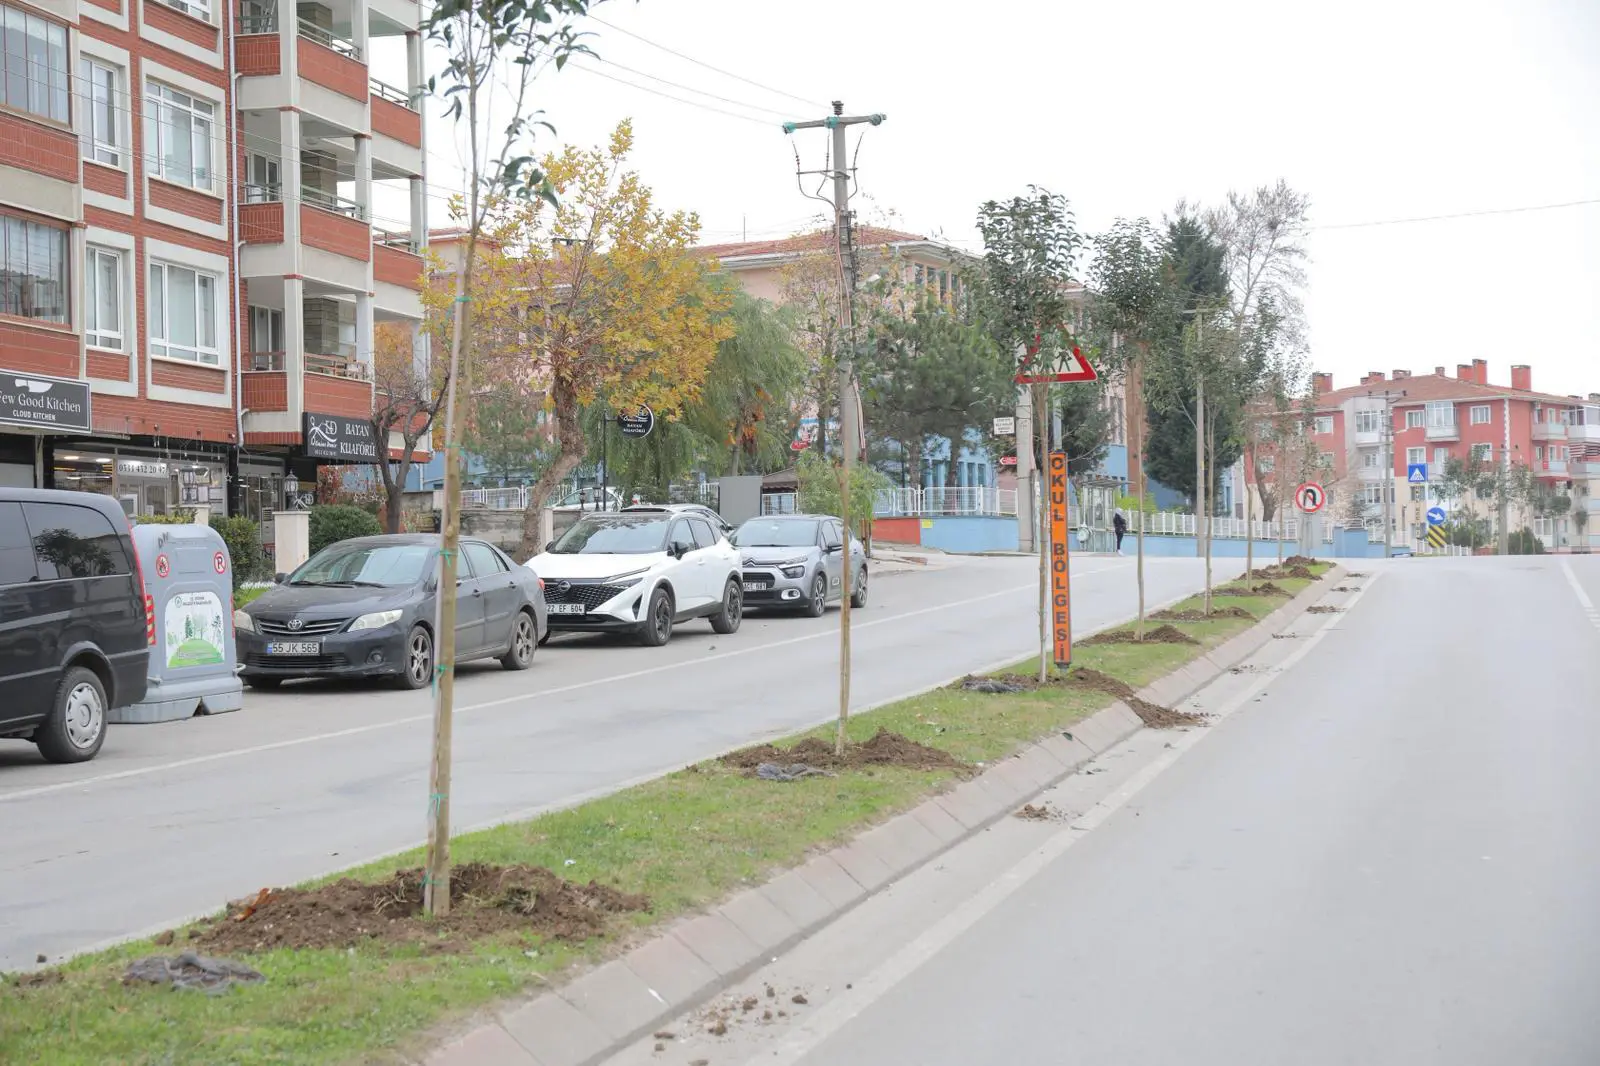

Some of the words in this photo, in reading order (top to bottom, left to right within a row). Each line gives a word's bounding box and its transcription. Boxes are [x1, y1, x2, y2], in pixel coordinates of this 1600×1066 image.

[18, 393, 44, 408] Good
[46, 396, 80, 412] Kitchen
[13, 410, 32, 418] CLOUD
[33, 412, 56, 420] KITCHEN
[346, 424, 370, 436] BAYAN
[1054, 543, 1066, 661] BÖLGESİ
[272, 644, 284, 652] 55
[286, 644, 298, 652] JK
[302, 644, 318, 652] 565
